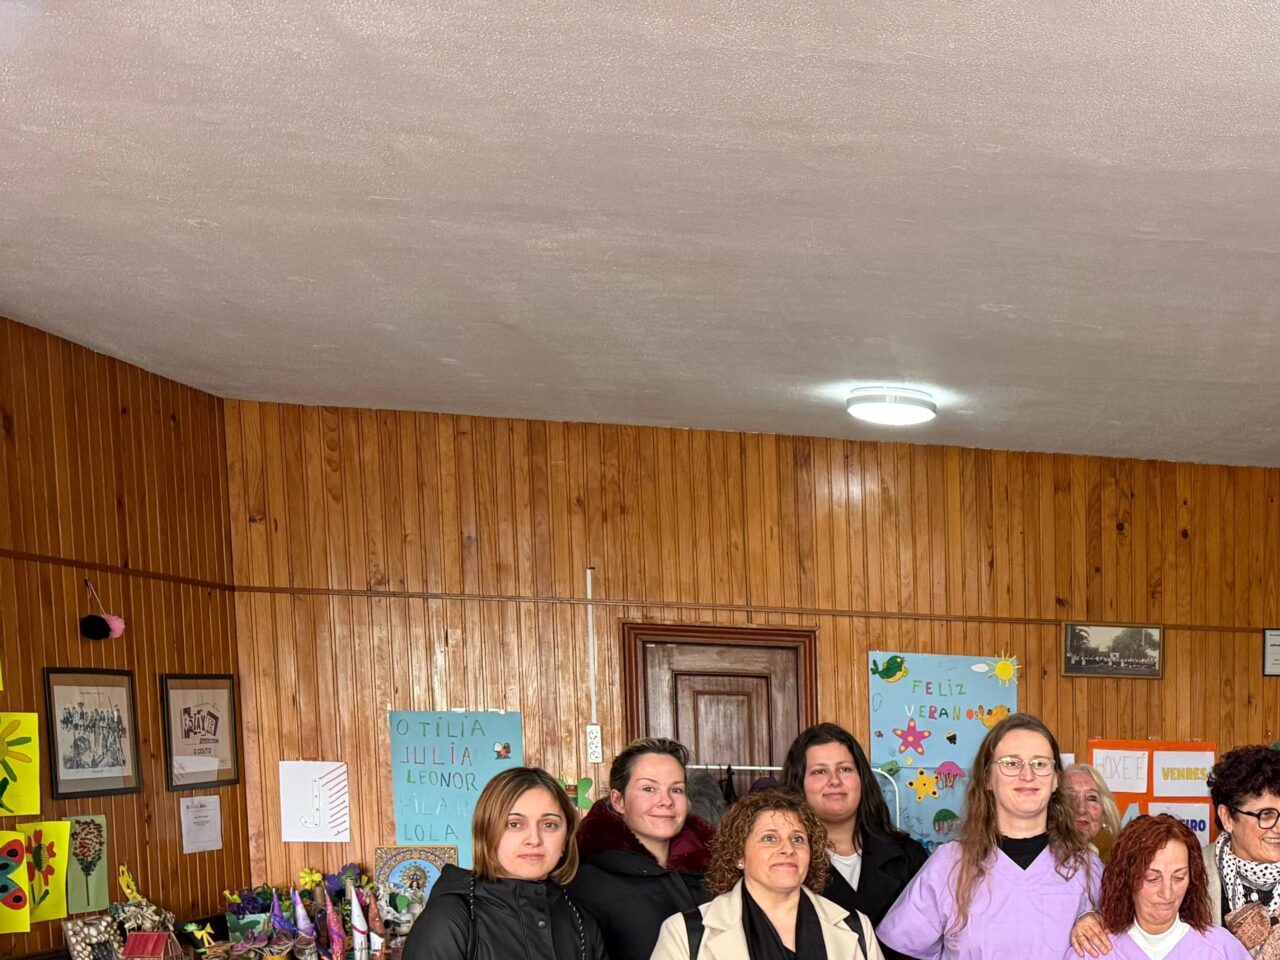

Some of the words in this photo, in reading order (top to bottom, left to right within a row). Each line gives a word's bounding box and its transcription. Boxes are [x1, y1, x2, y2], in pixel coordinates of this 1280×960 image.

[905, 704, 974, 720] VERANO
[407, 769, 478, 791] LEONOR
[404, 824, 459, 841] LOLA
